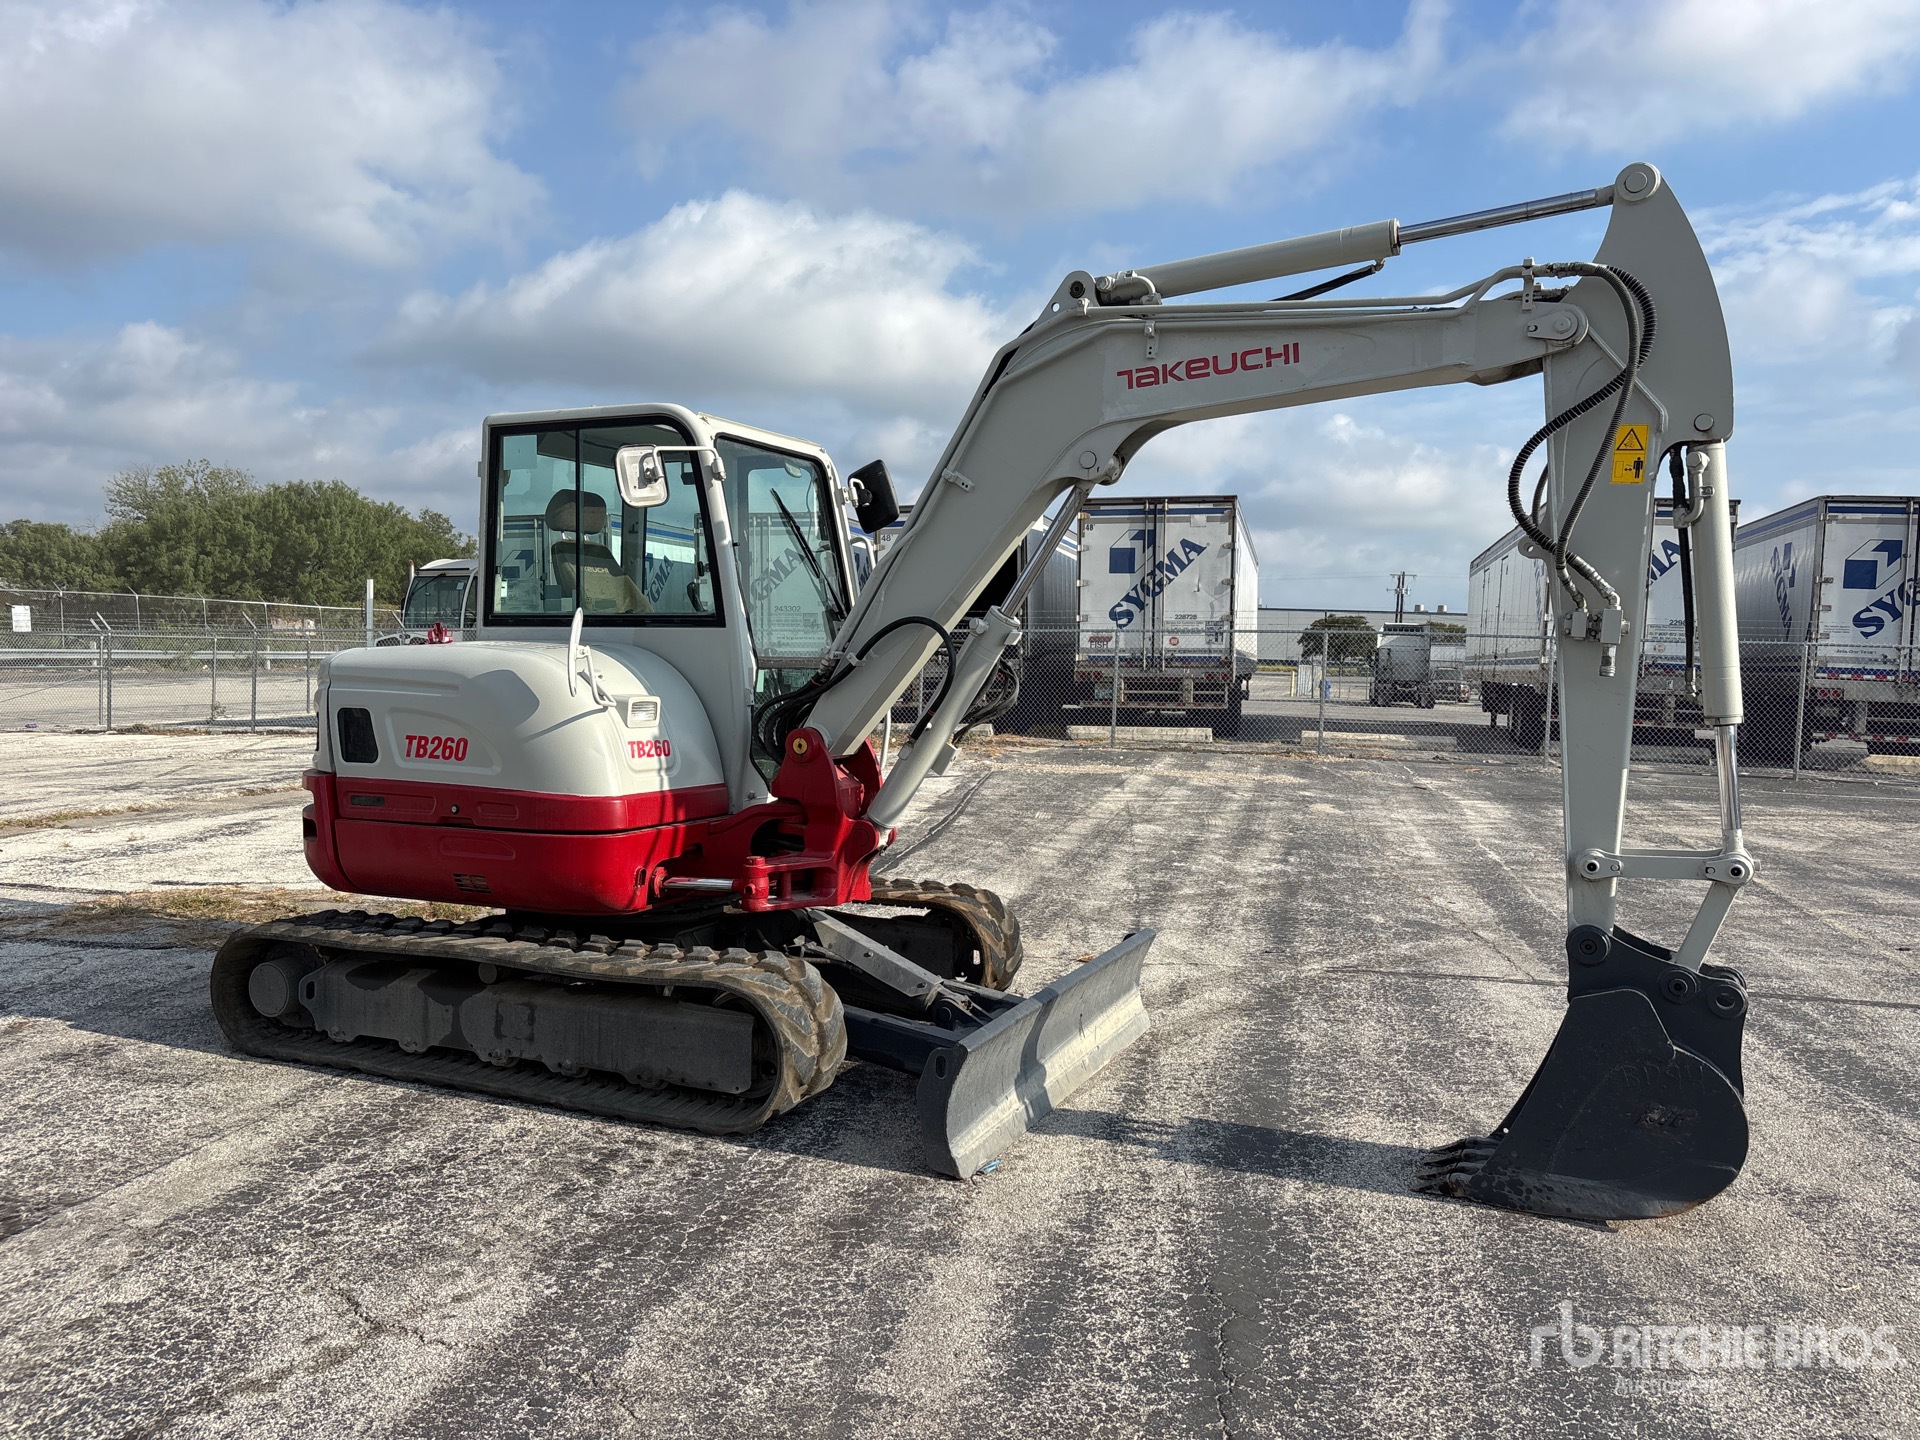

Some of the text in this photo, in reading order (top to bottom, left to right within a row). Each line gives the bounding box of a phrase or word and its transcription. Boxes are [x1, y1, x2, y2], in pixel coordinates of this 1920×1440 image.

[1108, 538, 1207, 629] SYGMA
[774, 605, 802, 613] 243302
[1089, 640, 1109, 649] FISH
[405, 735, 469, 761] TB260
[627, 739, 671, 759] TB260
